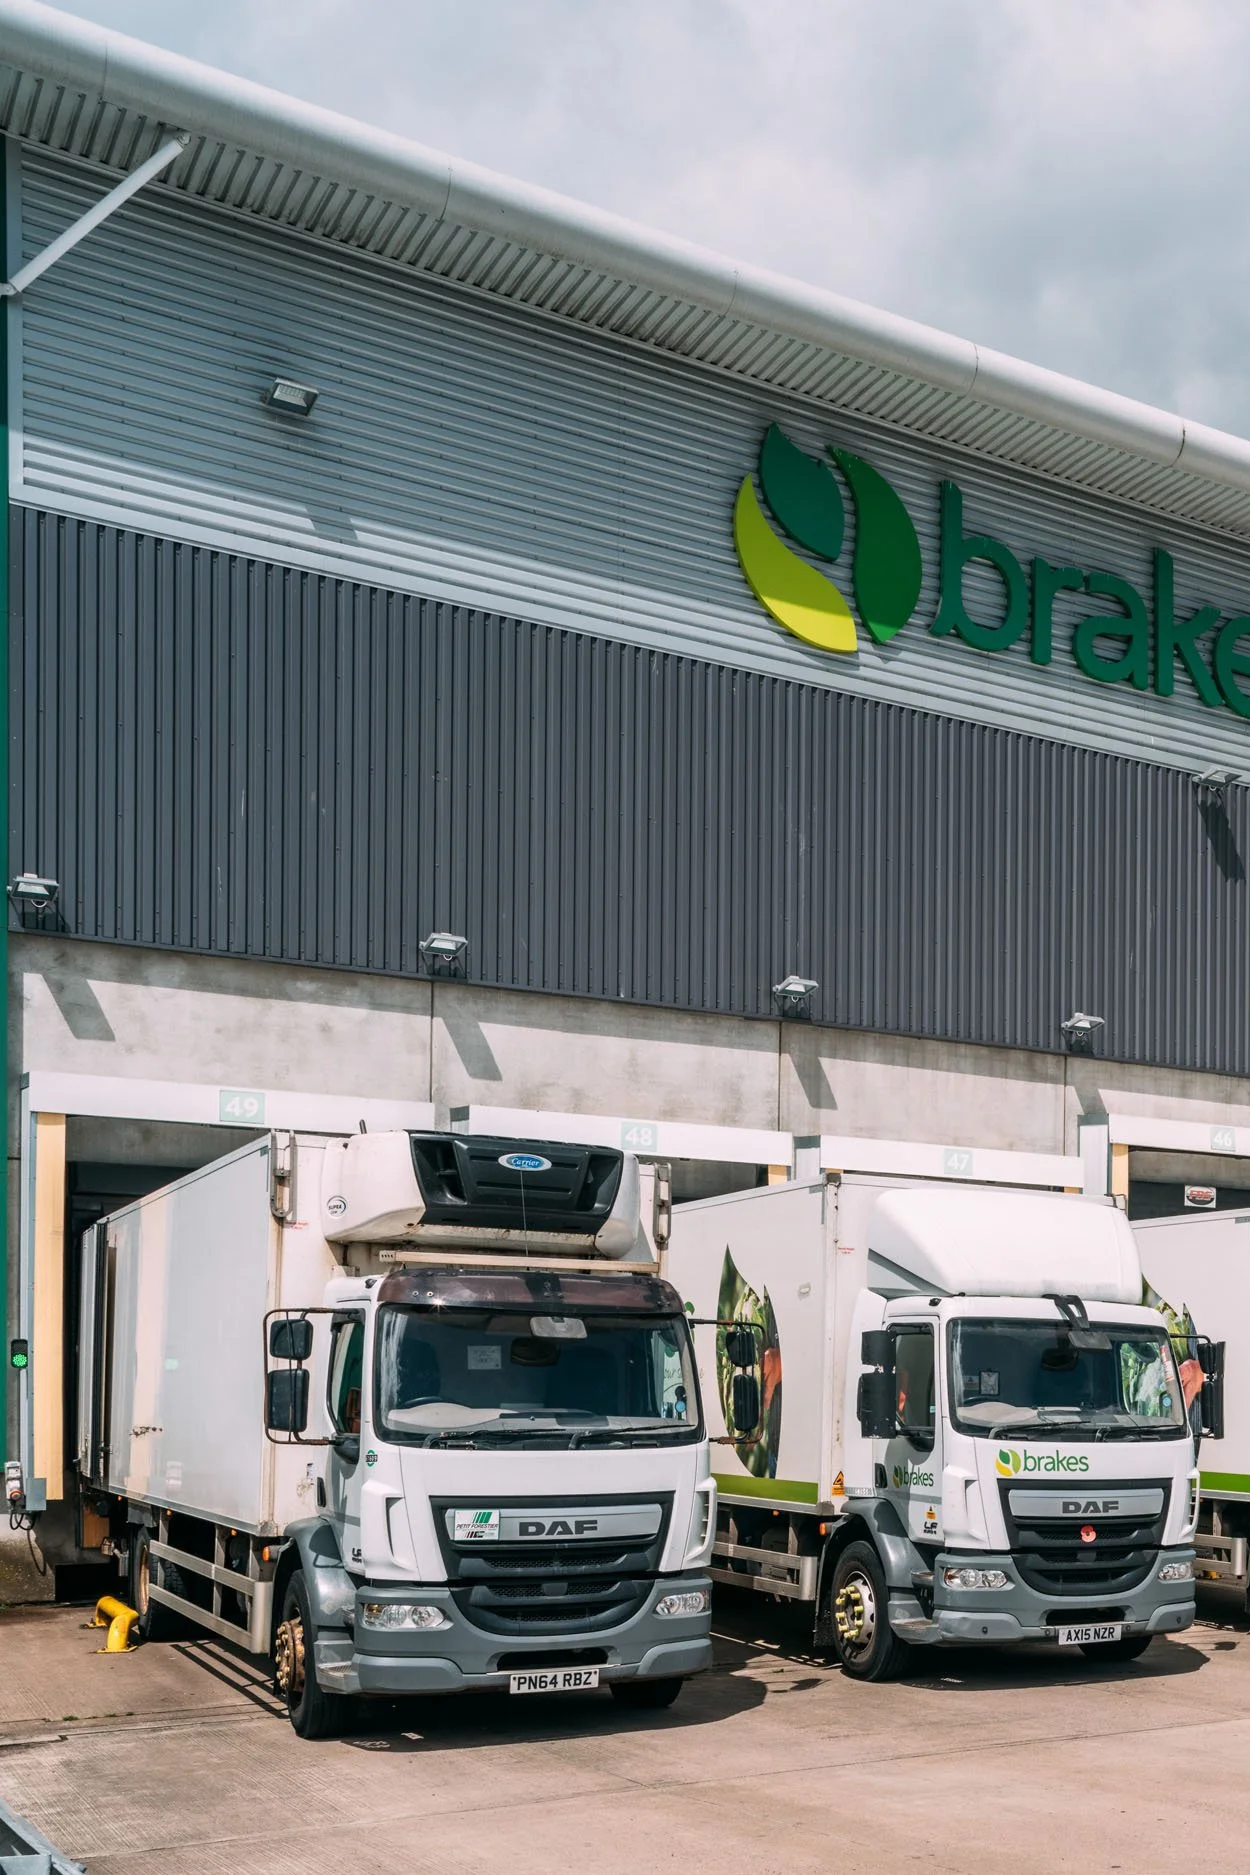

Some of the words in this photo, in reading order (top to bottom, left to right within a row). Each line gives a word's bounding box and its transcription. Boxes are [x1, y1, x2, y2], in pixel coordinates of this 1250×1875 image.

[224, 1096, 259, 1118] 49
[624, 1127, 653, 1147] 48
[1213, 1131, 1233, 1148] 46
[511, 1157, 540, 1167] Carrier
[947, 1153, 970, 1172] 47
[1023, 1449, 1090, 1472] brakes
[903, 1466, 934, 1487] brakes
[1061, 1500, 1120, 1514] DAF
[518, 1519, 598, 1537] DAF
[923, 1521, 938, 1529] LF
[1065, 1628, 1091, 1642] AX15
[1093, 1626, 1116, 1640] NZR
[517, 1673, 559, 1691] PN64
[562, 1671, 593, 1687] RBZ
